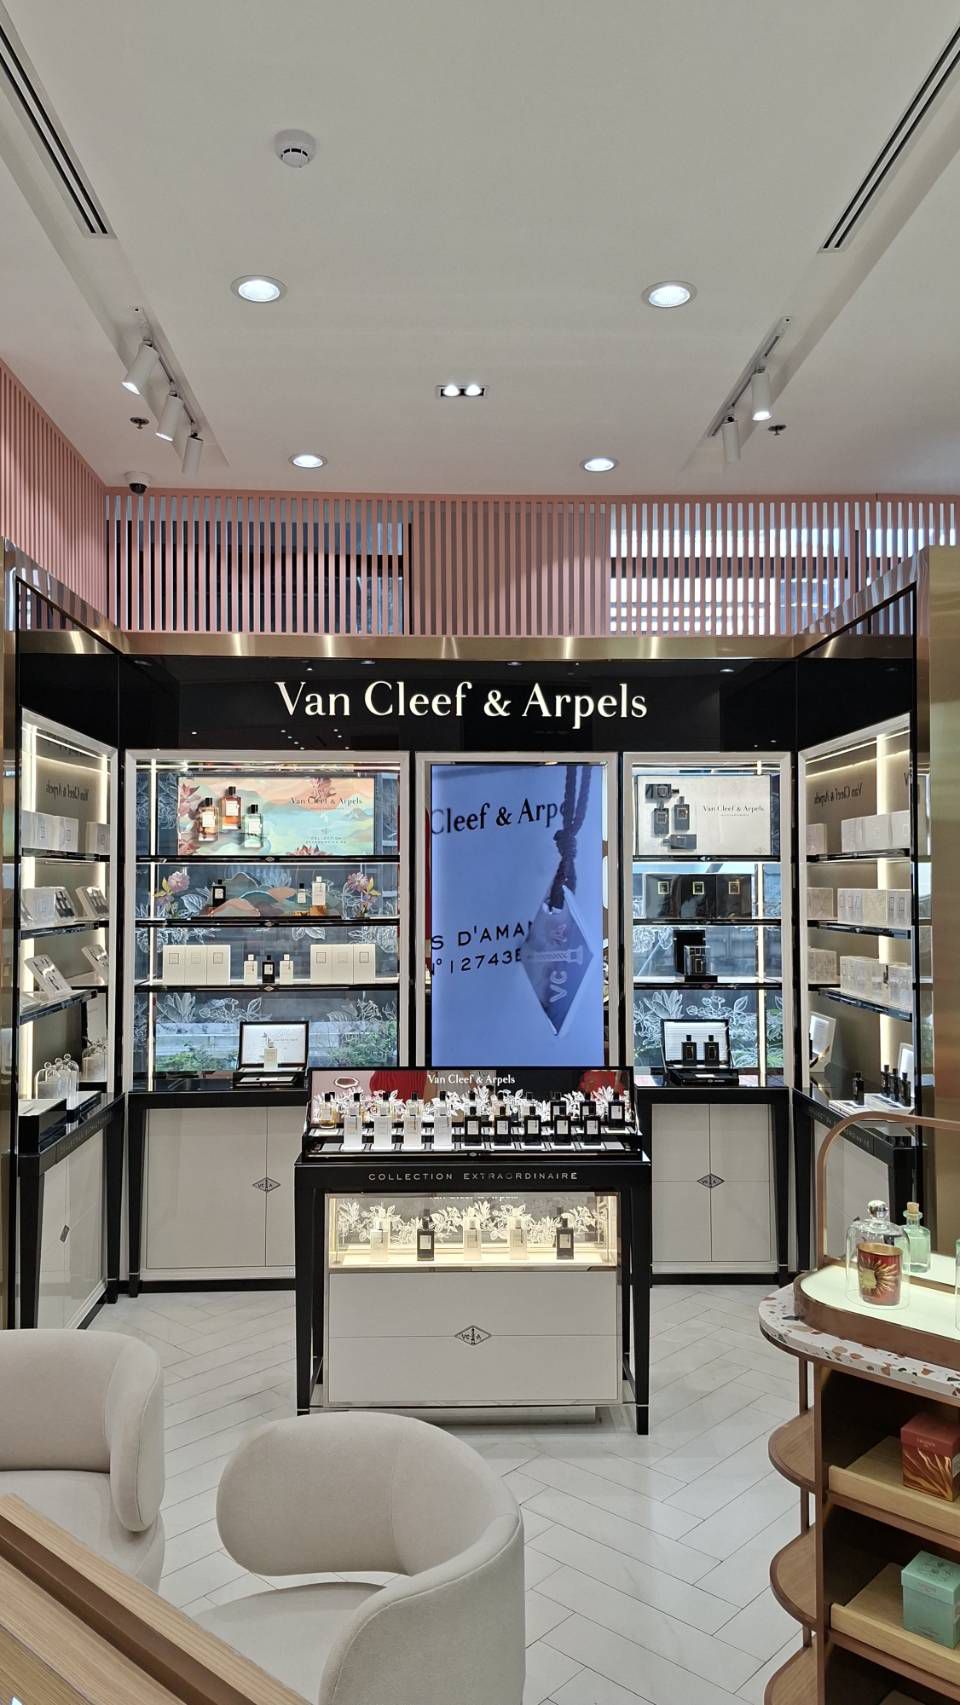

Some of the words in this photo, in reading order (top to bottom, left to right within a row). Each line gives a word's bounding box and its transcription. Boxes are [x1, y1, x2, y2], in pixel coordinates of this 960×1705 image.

[275, 681, 350, 717] Van
[364, 681, 472, 717] Cleef
[484, 690, 511, 717] &
[522, 683, 648, 730] Arpels
[432, 802, 490, 834] Cleef
[495, 806, 512, 826] &
[427, 1074, 445, 1084] Van
[448, 1073, 474, 1084] Cleef
[485, 1074, 516, 1086] Arpels
[368, 1173, 453, 1181] COLLECTION
[463, 1172, 578, 1180] EXTRAORDINAIRE
